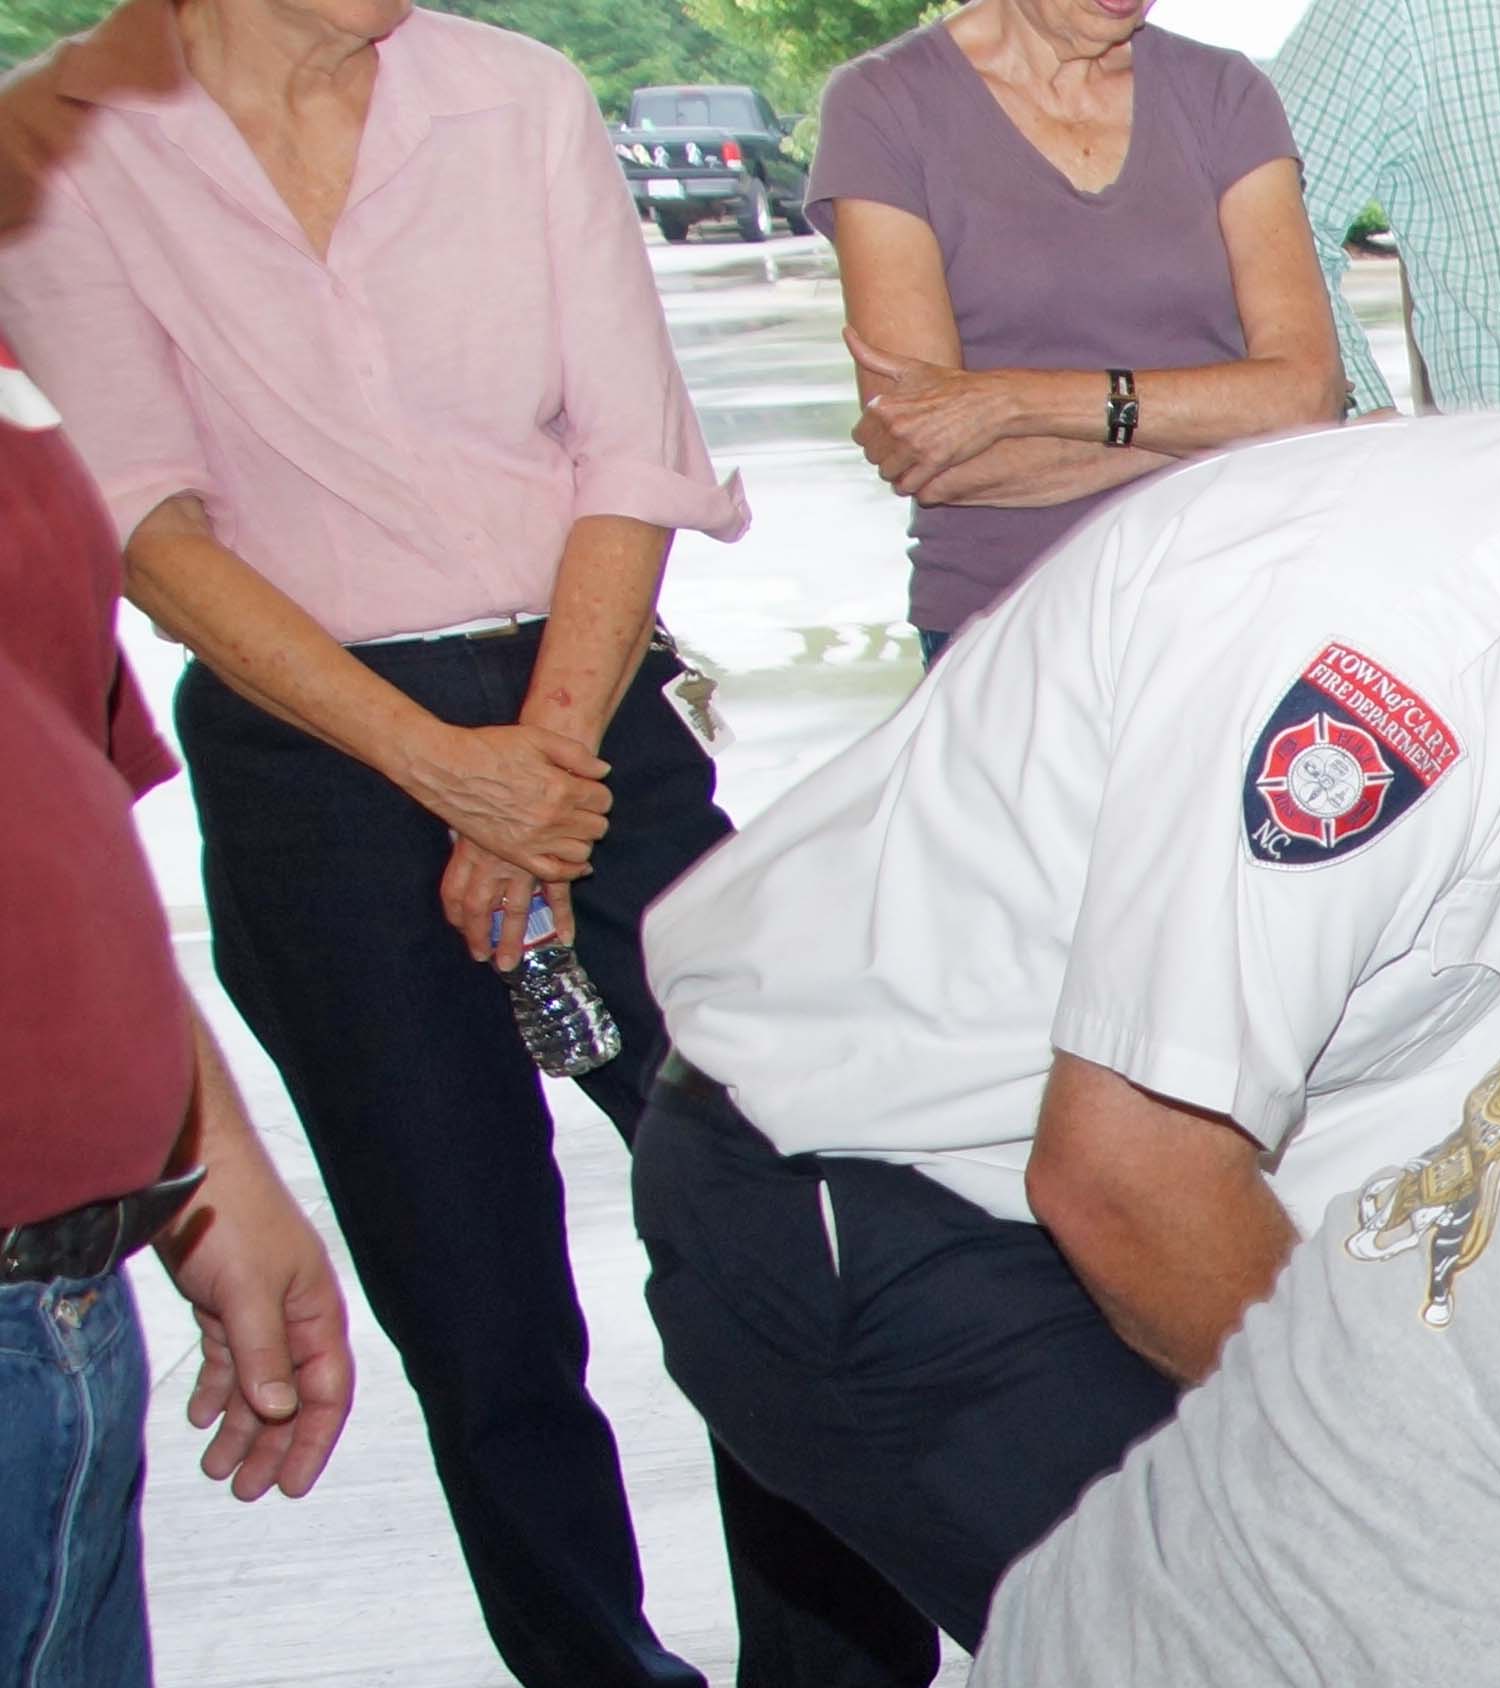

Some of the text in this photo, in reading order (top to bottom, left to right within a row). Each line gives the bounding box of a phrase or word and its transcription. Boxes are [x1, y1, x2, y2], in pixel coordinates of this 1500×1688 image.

[1308, 663, 1441, 781] FIRE DEPARTMENT
[1323, 646, 1395, 700] TOWN
[1404, 706, 1455, 764] CARY
